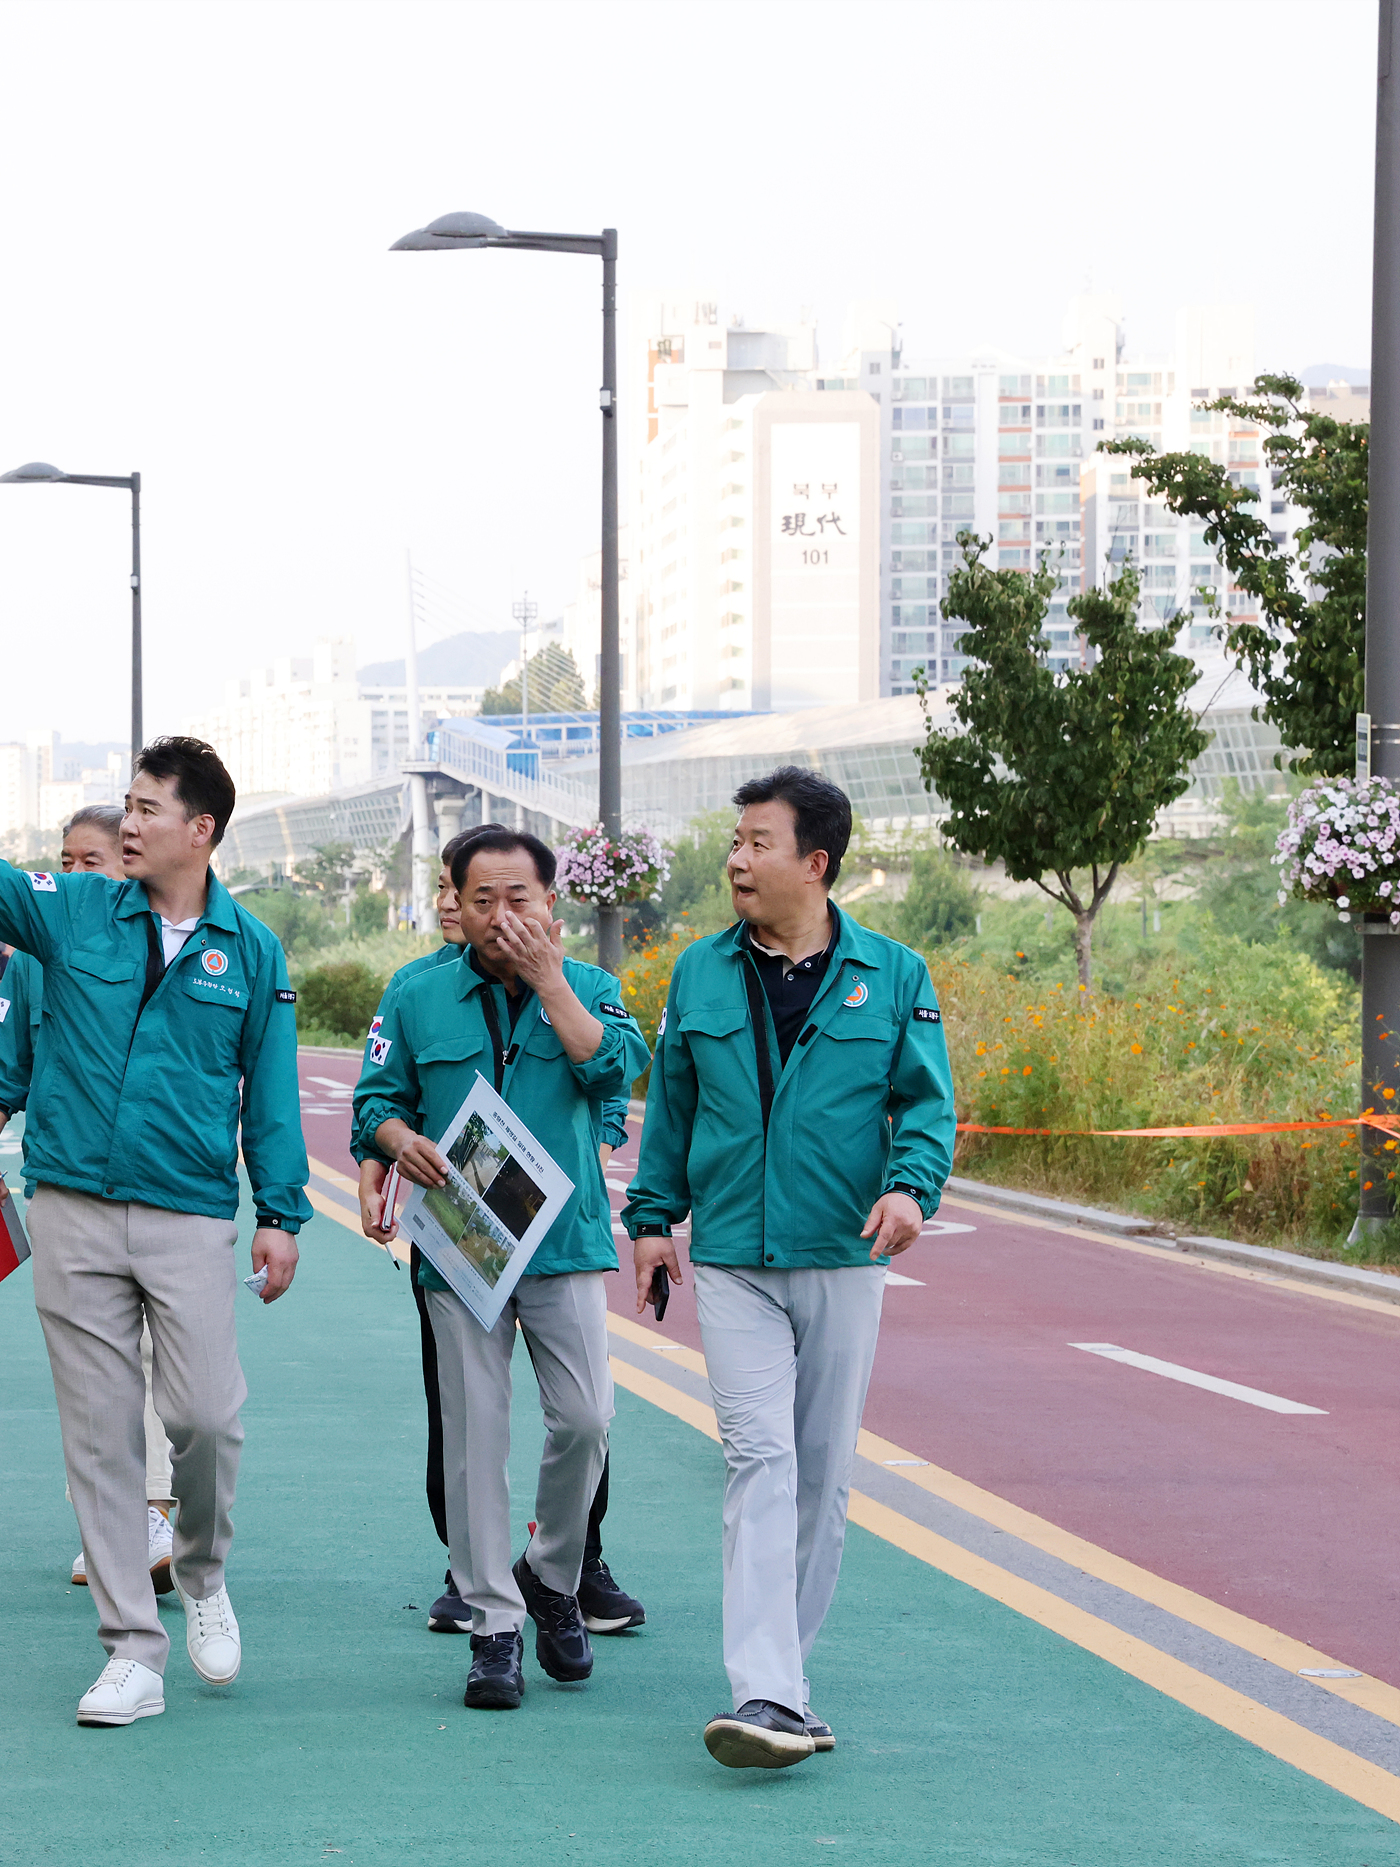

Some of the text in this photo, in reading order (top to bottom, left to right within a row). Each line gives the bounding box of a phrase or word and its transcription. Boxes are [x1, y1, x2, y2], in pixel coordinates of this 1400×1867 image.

[793, 483, 837, 500] 북부
[781, 511, 847, 537] 現代
[802, 549, 829, 565] 101
[918, 1009, 940, 1020] 서울 도봉구
